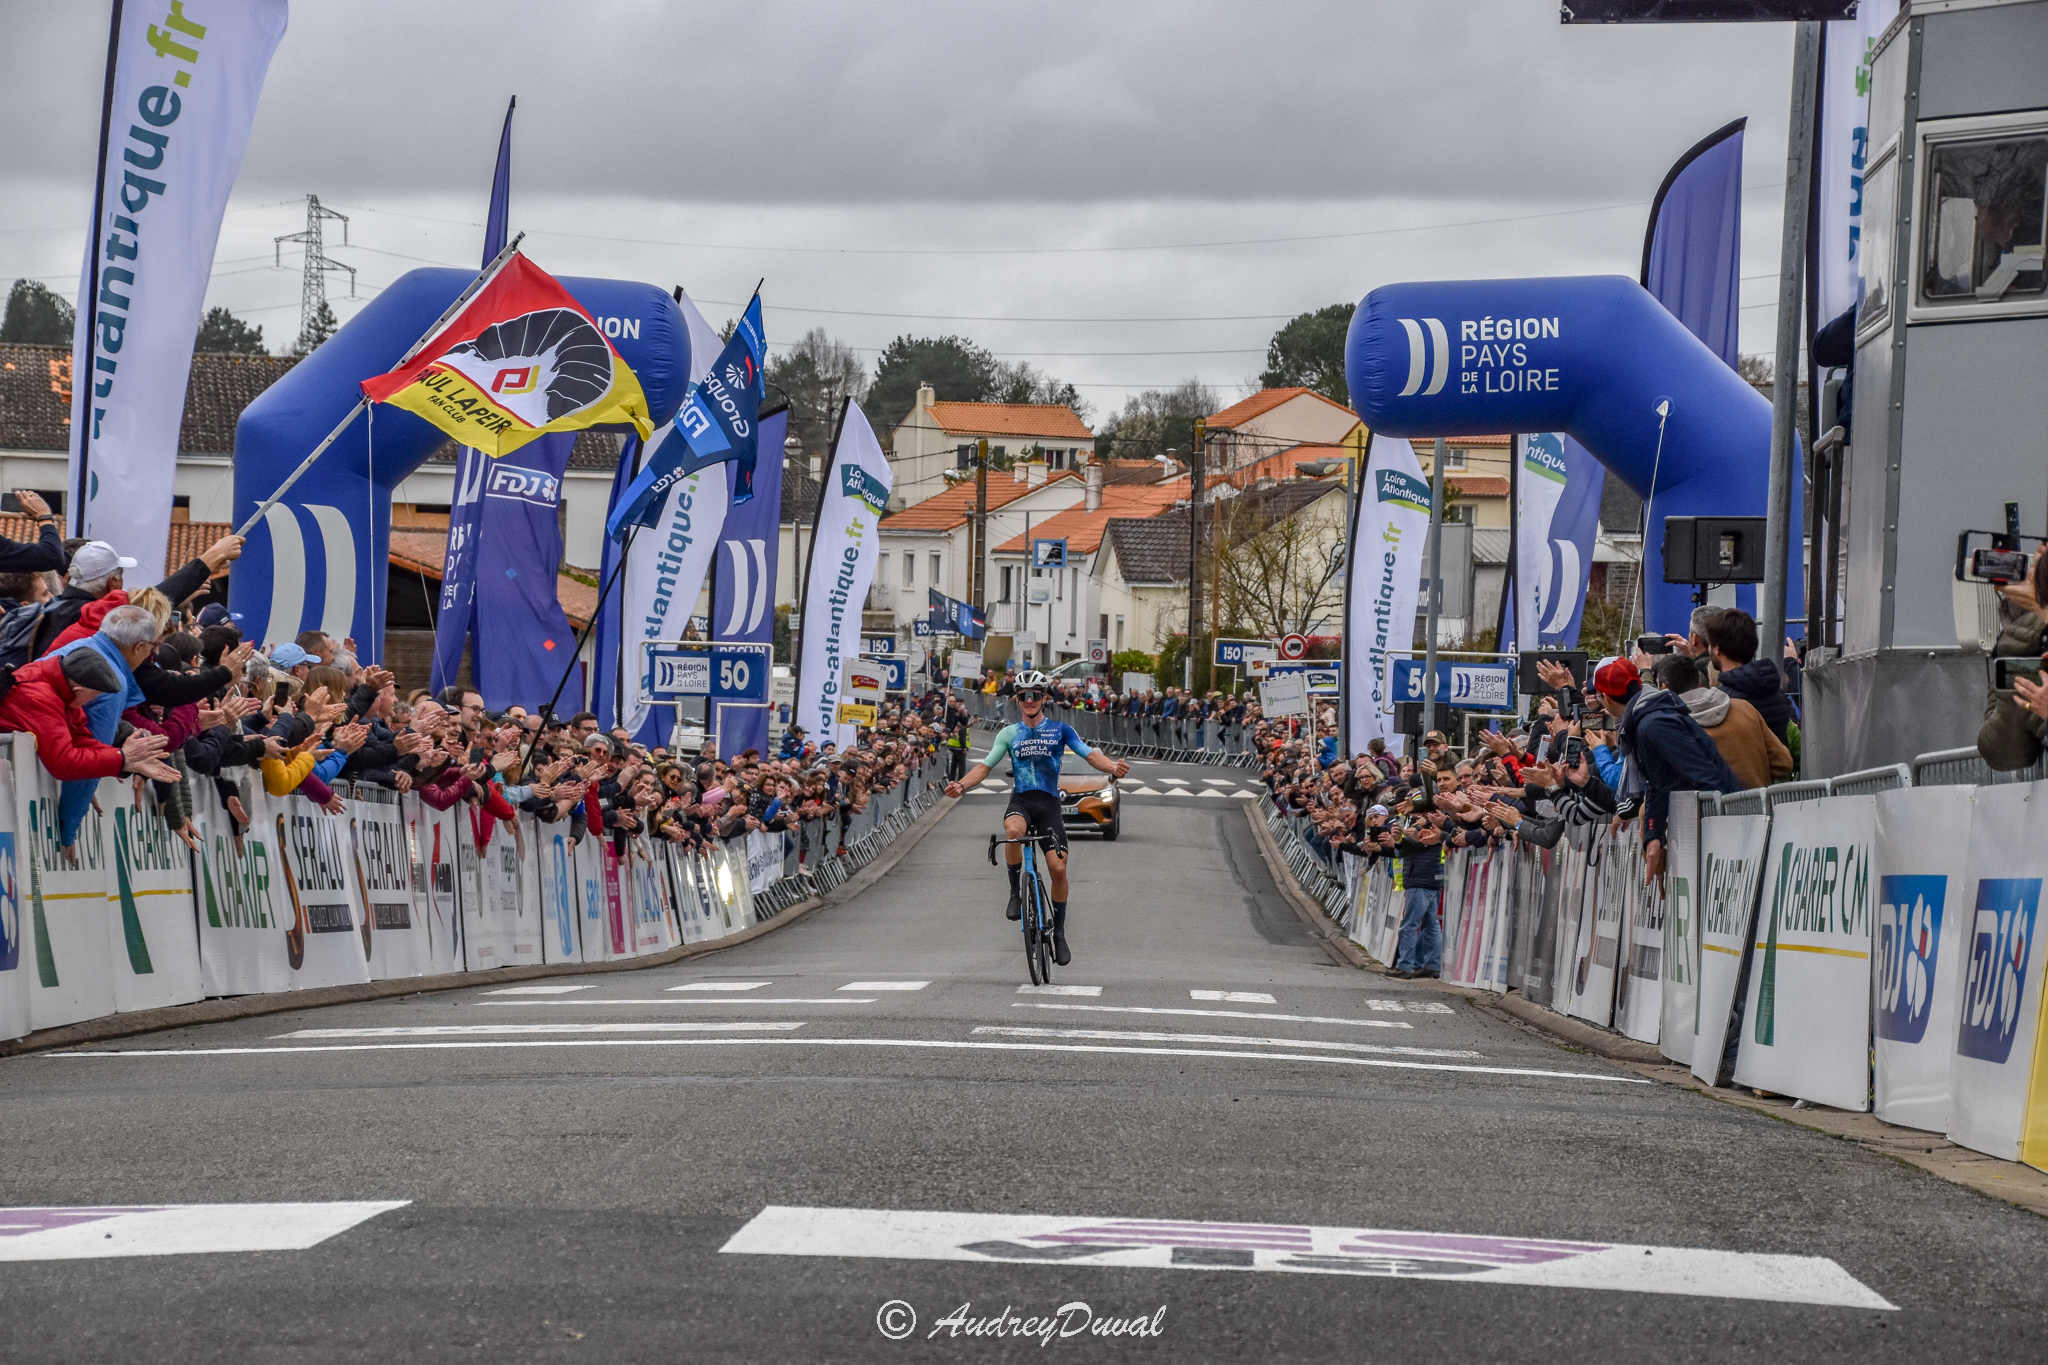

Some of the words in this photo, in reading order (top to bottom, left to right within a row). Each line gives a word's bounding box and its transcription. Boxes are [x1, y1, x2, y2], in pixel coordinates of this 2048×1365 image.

[1461, 315, 1560, 342] RÉGION
[1461, 343, 1527, 368] PAYS
[1461, 384, 1478, 394] LA
[1486, 368, 1560, 393] LOIRE
[1462, 371, 1478, 382] DE
[410, 368, 451, 394] PAUL
[447, 387, 513, 437] LAPEIR
[427, 394, 446, 411] FAN
[441, 405, 466, 425] CLUB
[1526, 446, 1567, 472] ntique
[493, 470, 541, 496] FDJ
[1384, 471, 1407, 486] Loire
[846, 477, 885, 507] Atltique
[1381, 485, 1430, 507] Atlantique
[819, 517, 866, 735] loire-atlantique.fr
[917, 622, 930, 634] 20
[872, 640, 889, 653] 150
[1223, 646, 1241, 660] 150
[677, 662, 707, 672] RÉGION
[720, 660, 750, 691] 50
[1474, 674, 1506, 683] RÉGION
[1482, 691, 1505, 700] LOIRE
[291, 814, 345, 891] SERALU
[362, 818, 407, 891] SERALU
[216, 833, 277, 930] CHARIER
[1785, 844, 1839, 934] CHARIER
[1842, 841, 1869, 937] CM
[1963, 909, 2012, 1031] FDJ
